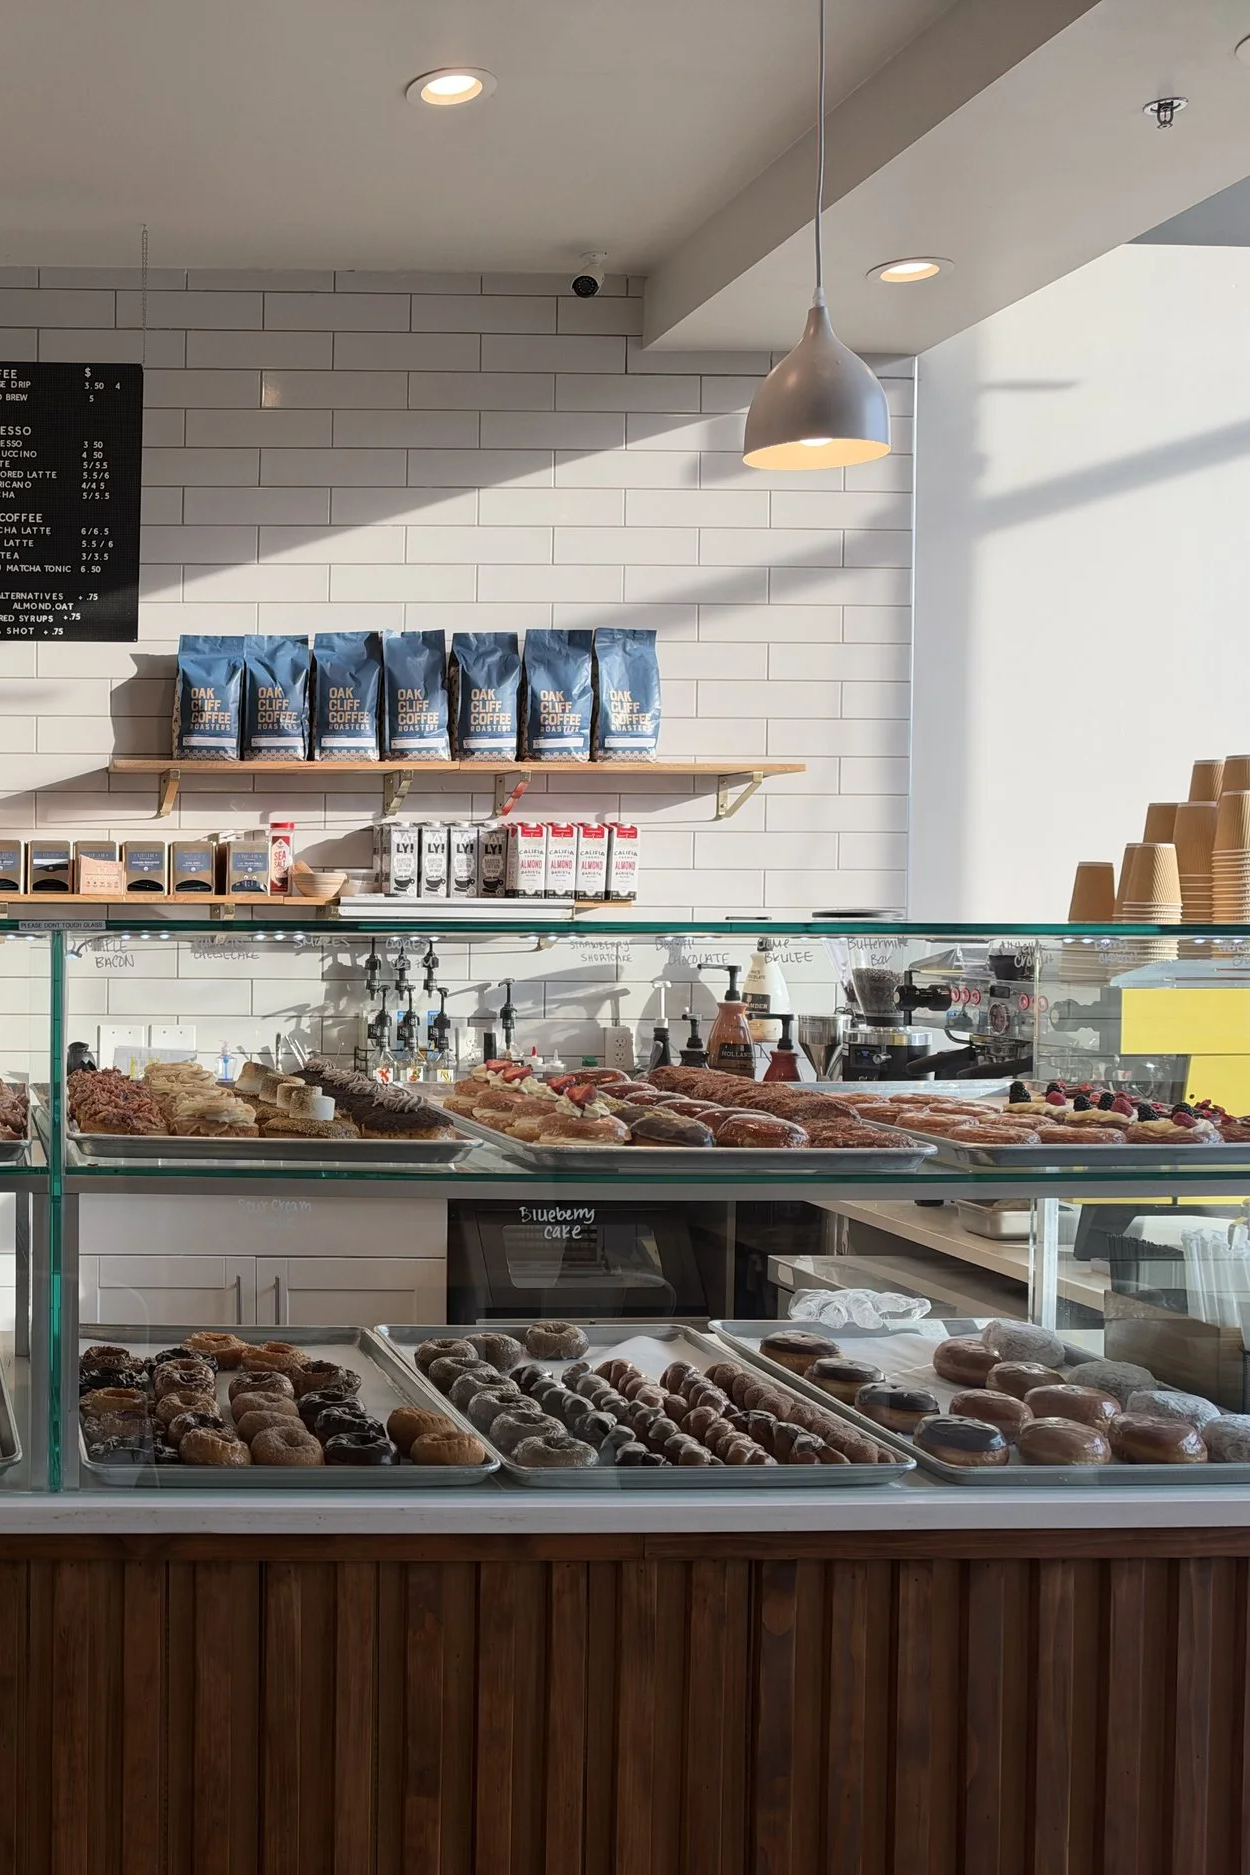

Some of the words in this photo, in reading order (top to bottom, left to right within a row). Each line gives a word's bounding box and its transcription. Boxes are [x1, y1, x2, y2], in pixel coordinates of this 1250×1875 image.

[10, 380, 31, 389] DRIP
[27, 471, 57, 479] LATTE
[21, 527, 51, 535] LATTE
[4, 539, 34, 547] LATTE
[6, 564, 41, 572] MATCHA
[44, 565, 72, 573] TONIC
[6, 627, 34, 635] SHOT
[191, 687, 215, 699] OAK
[329, 687, 353, 699] OAK
[471, 688, 496, 700] OAK
[540, 690, 564, 701] OAK
[191, 700, 221, 711] CLIFF
[329, 699, 360, 711] CLIFF
[470, 700, 502, 713] CLIFF
[540, 701, 572, 713] CLIFF
[191, 712, 231, 724] COFFEE
[329, 712, 370, 723] COFFEE
[470, 712, 511, 725] COFFEE
[540, 713, 581, 725] COFFEE
[396, 843, 414, 853] LY!
[428, 843, 445, 853] LY!
[456, 843, 474, 854] LY!
[274, 851, 286, 861] SEA
[274, 859, 285, 868] SALT
[521, 860, 542, 869] ALMOND
[551, 860, 572, 869] ALMOND
[581, 861, 603, 870] ALMOND
[615, 861, 636, 870] ALMOND
[847, 936, 909, 951] Buttermilk
[95, 956, 135, 968] BACON
[580, 953, 632, 962] SHORTCAKE
[870, 953, 892, 967] Bar
[519, 1206, 595, 1224] Blueberry
[543, 1224, 582, 1239] cake
